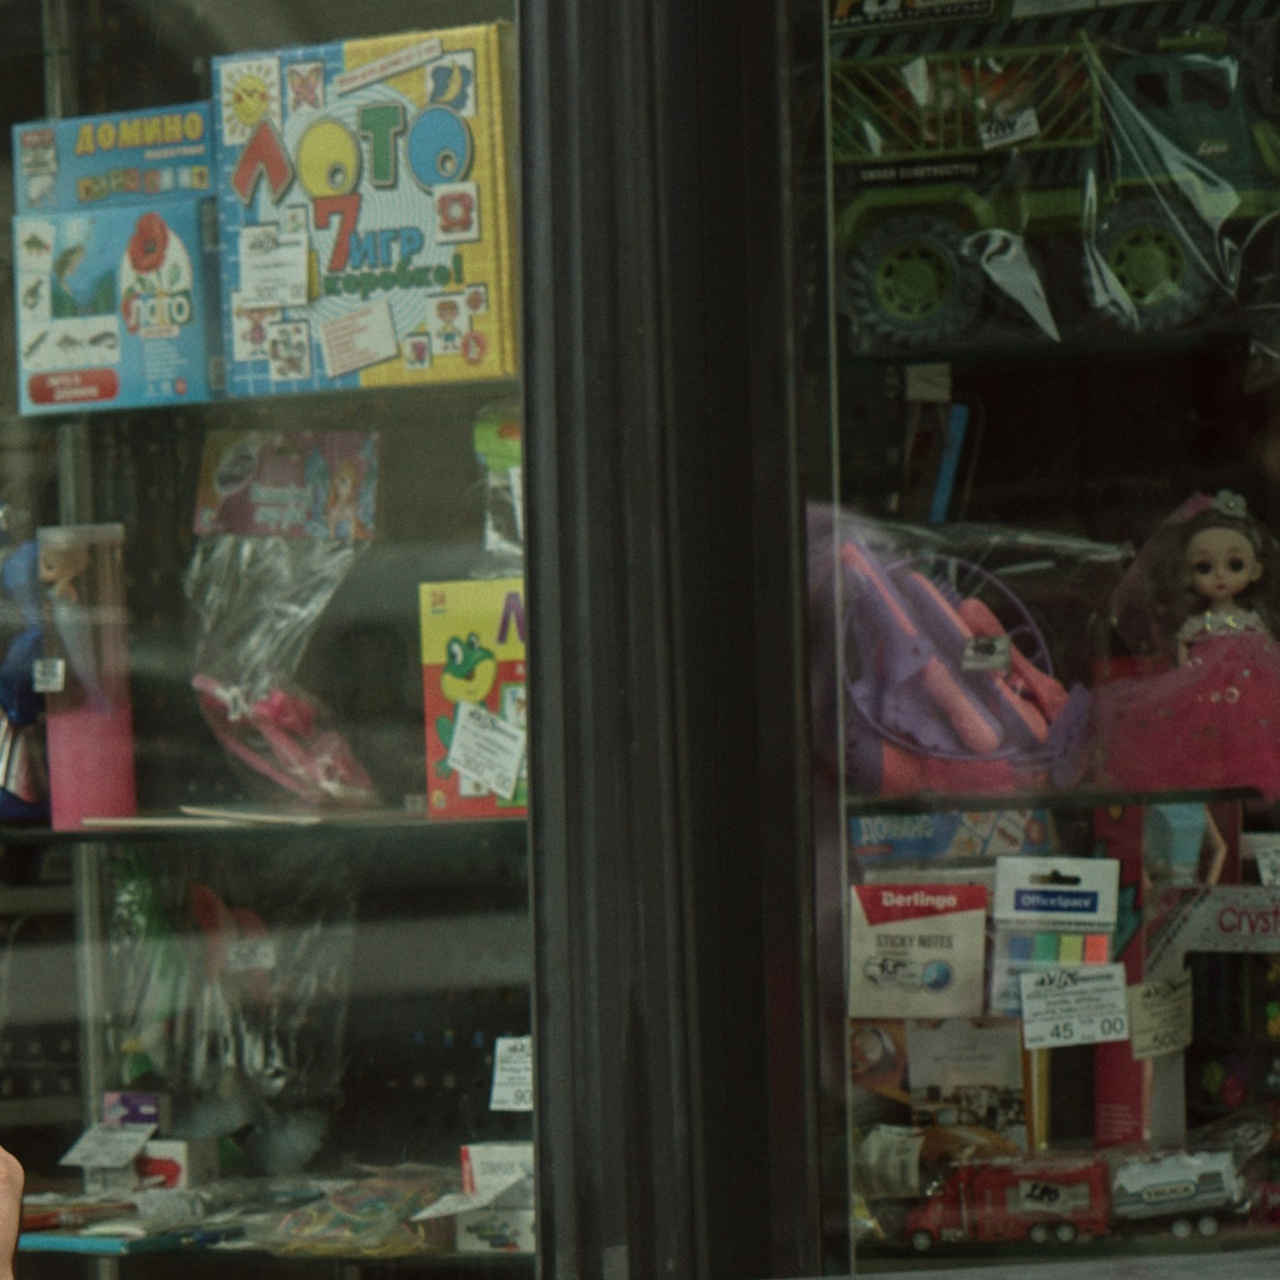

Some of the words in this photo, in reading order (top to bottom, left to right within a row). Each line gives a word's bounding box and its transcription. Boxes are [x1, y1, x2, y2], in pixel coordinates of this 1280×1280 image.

[75, 111, 204, 157] ДОМИНО
[231, 101, 472, 207] ЛОТО
[313, 193, 362, 273] 7
[349, 225, 425, 271] ИГР
[880, 890, 958, 910] Berlingo
[1021, 894, 1092, 909] OfficeSpace
[875, 934, 914, 948] STICKY
[917, 935, 953, 948] NOTES
[1049, 1022, 1074, 1040] 45
[1100, 1017, 1125, 1036] 00
